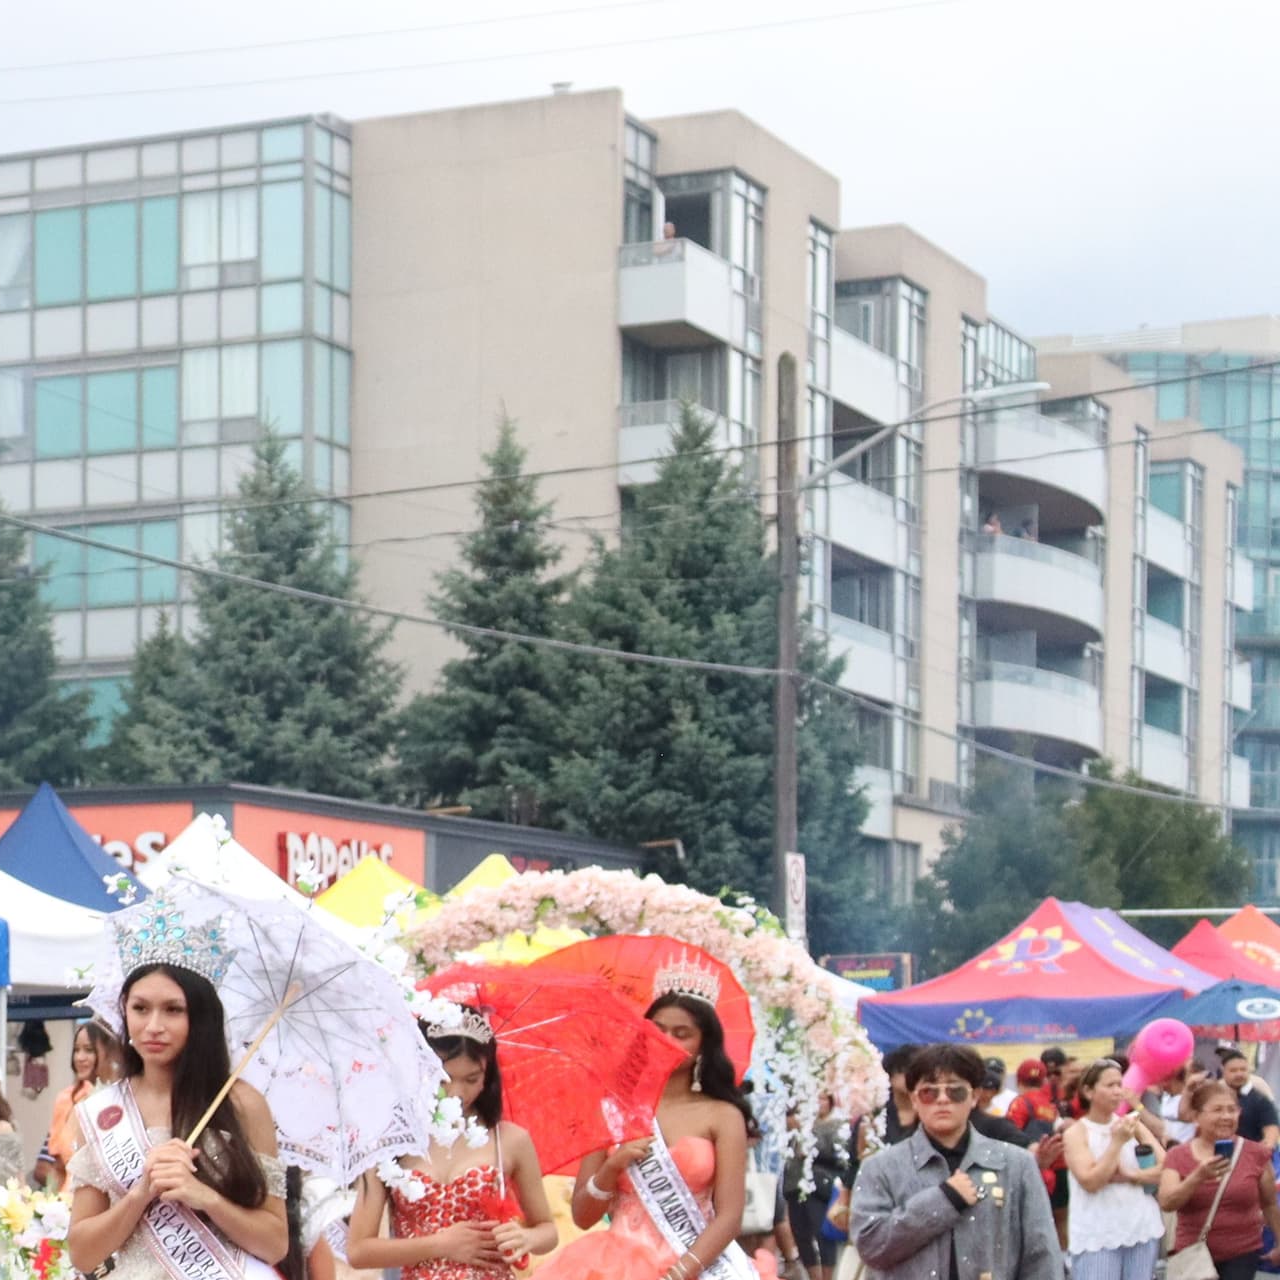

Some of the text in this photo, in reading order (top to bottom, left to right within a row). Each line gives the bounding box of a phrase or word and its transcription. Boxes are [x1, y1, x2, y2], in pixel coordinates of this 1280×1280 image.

[637, 1148, 662, 1179] ACE
[648, 1176, 673, 1195] OF
[158, 1203, 215, 1272] GLAMOUR
